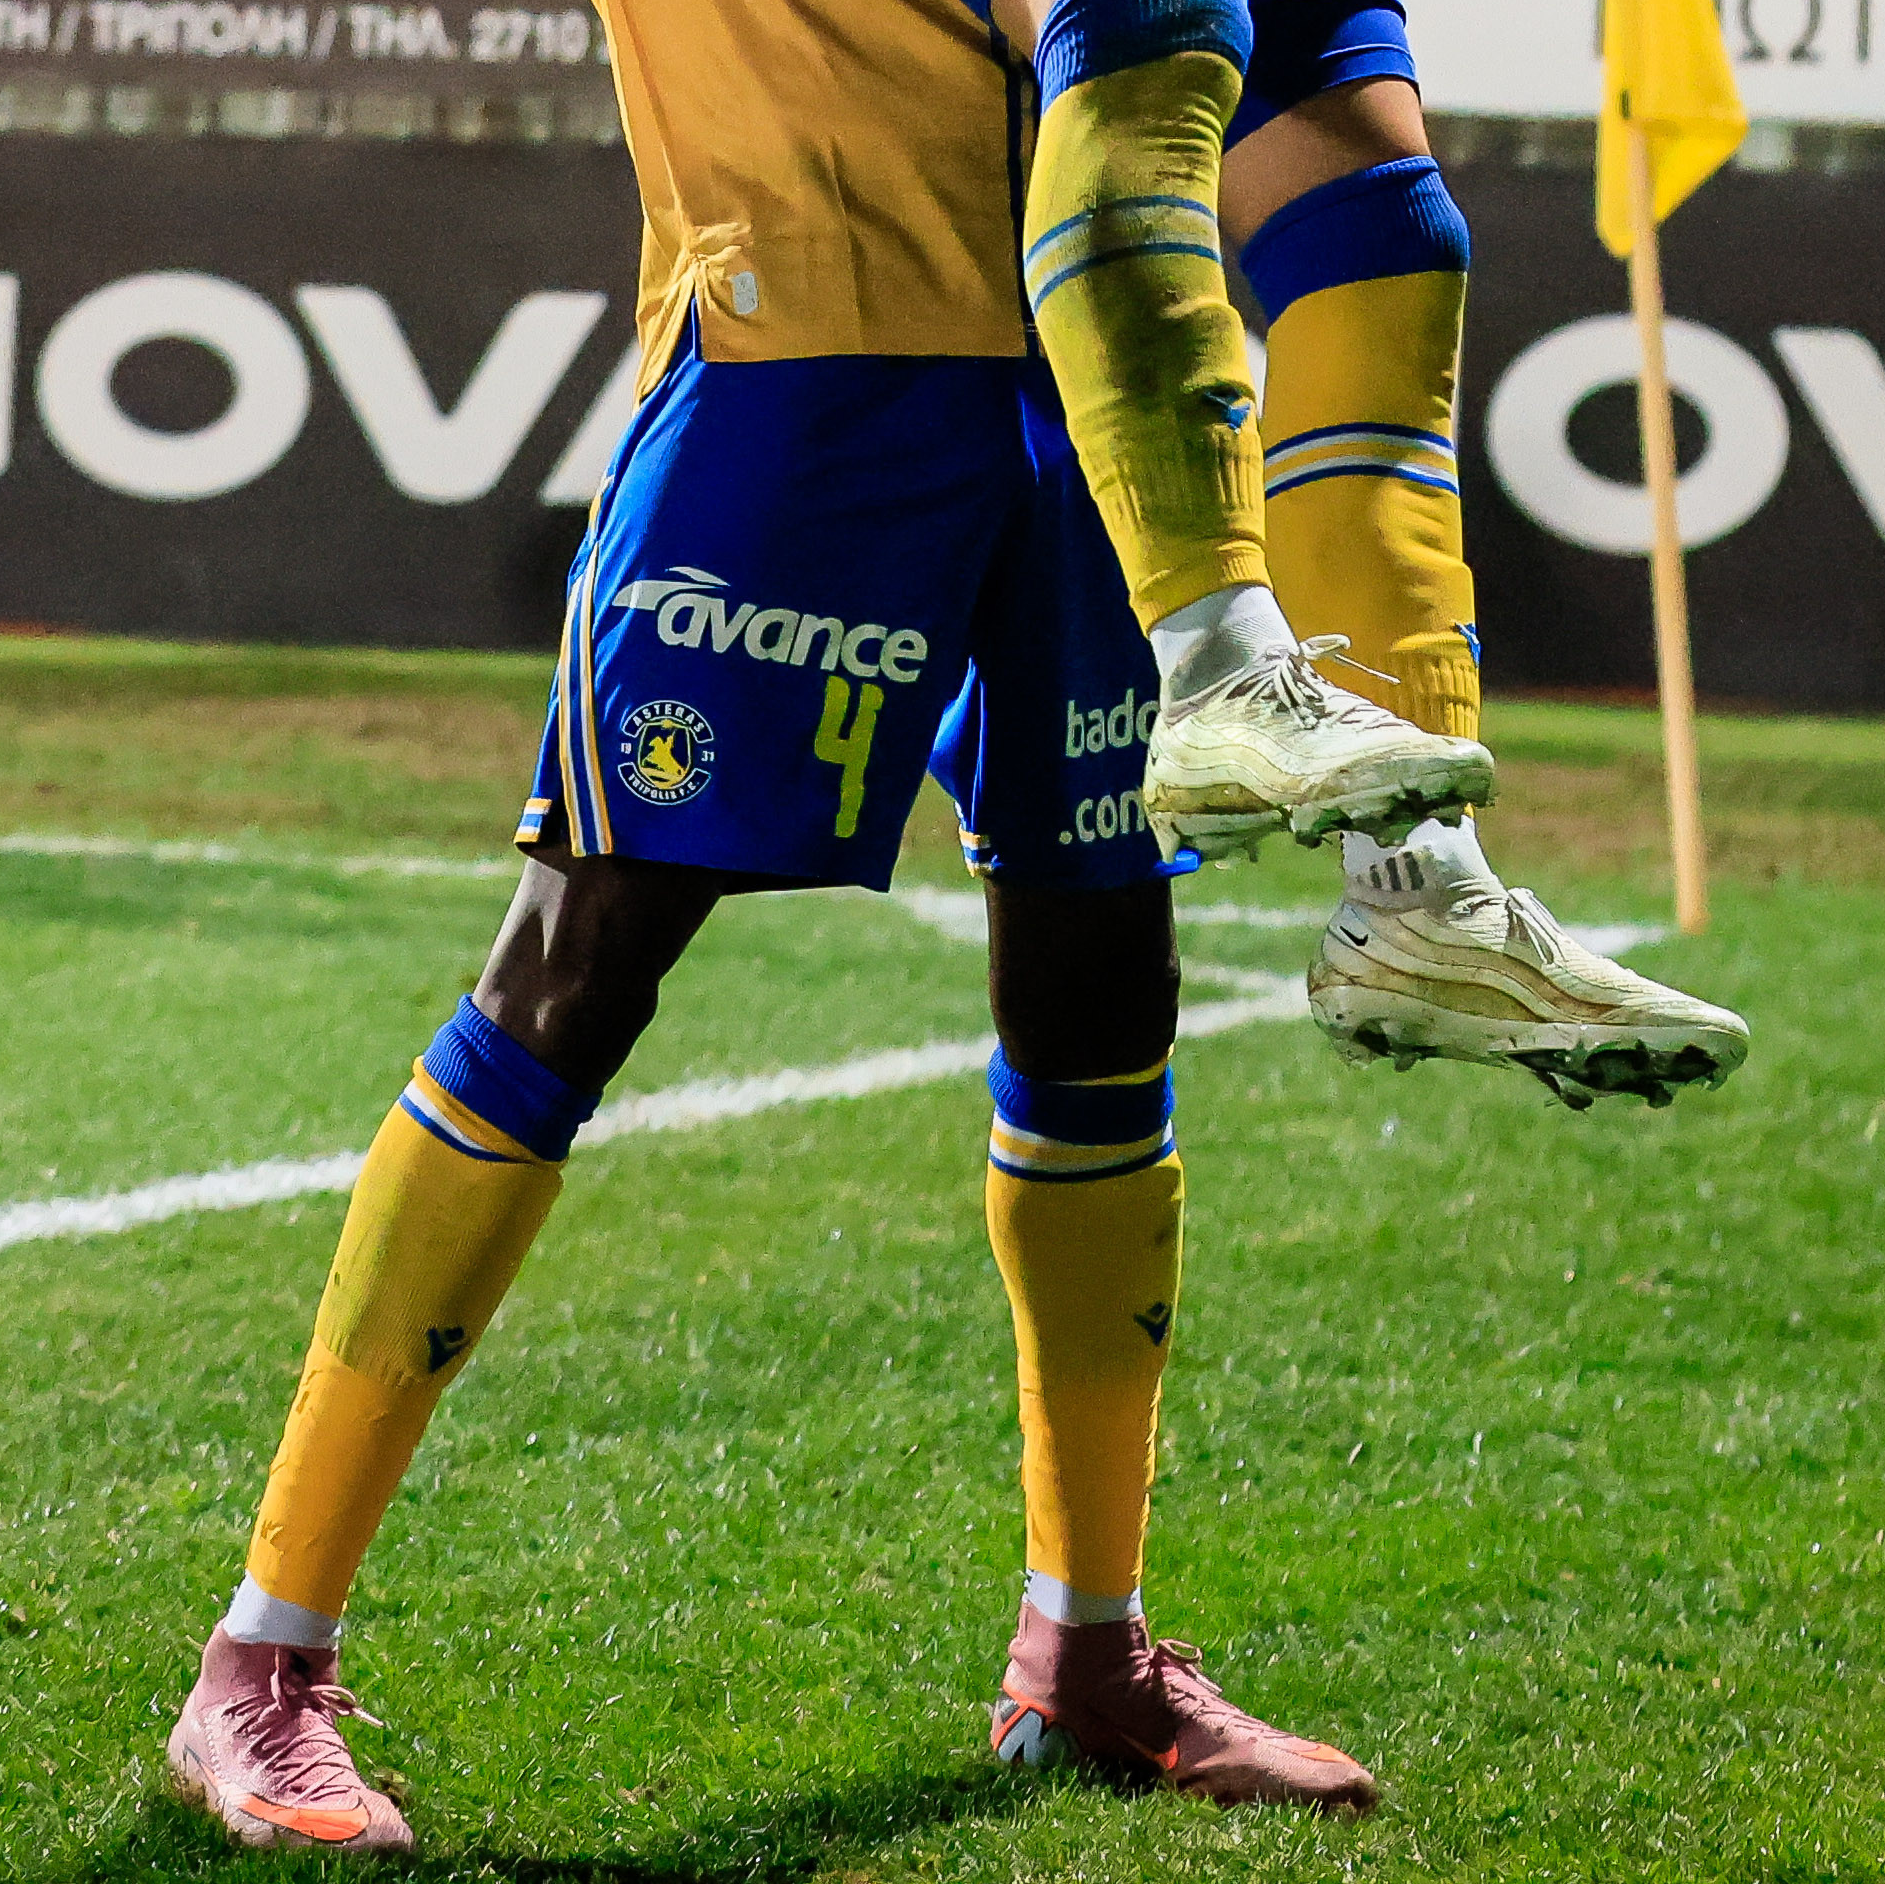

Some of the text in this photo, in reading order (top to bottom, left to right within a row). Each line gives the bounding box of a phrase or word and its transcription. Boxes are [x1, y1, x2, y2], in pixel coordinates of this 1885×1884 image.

[346, 2, 459, 62] ΤΗΛ.
[467, 6, 592, 66] 2710
[657, 592, 928, 683] avance
[632, 703, 705, 733] ASTERAS
[813, 675, 883, 838] 4
